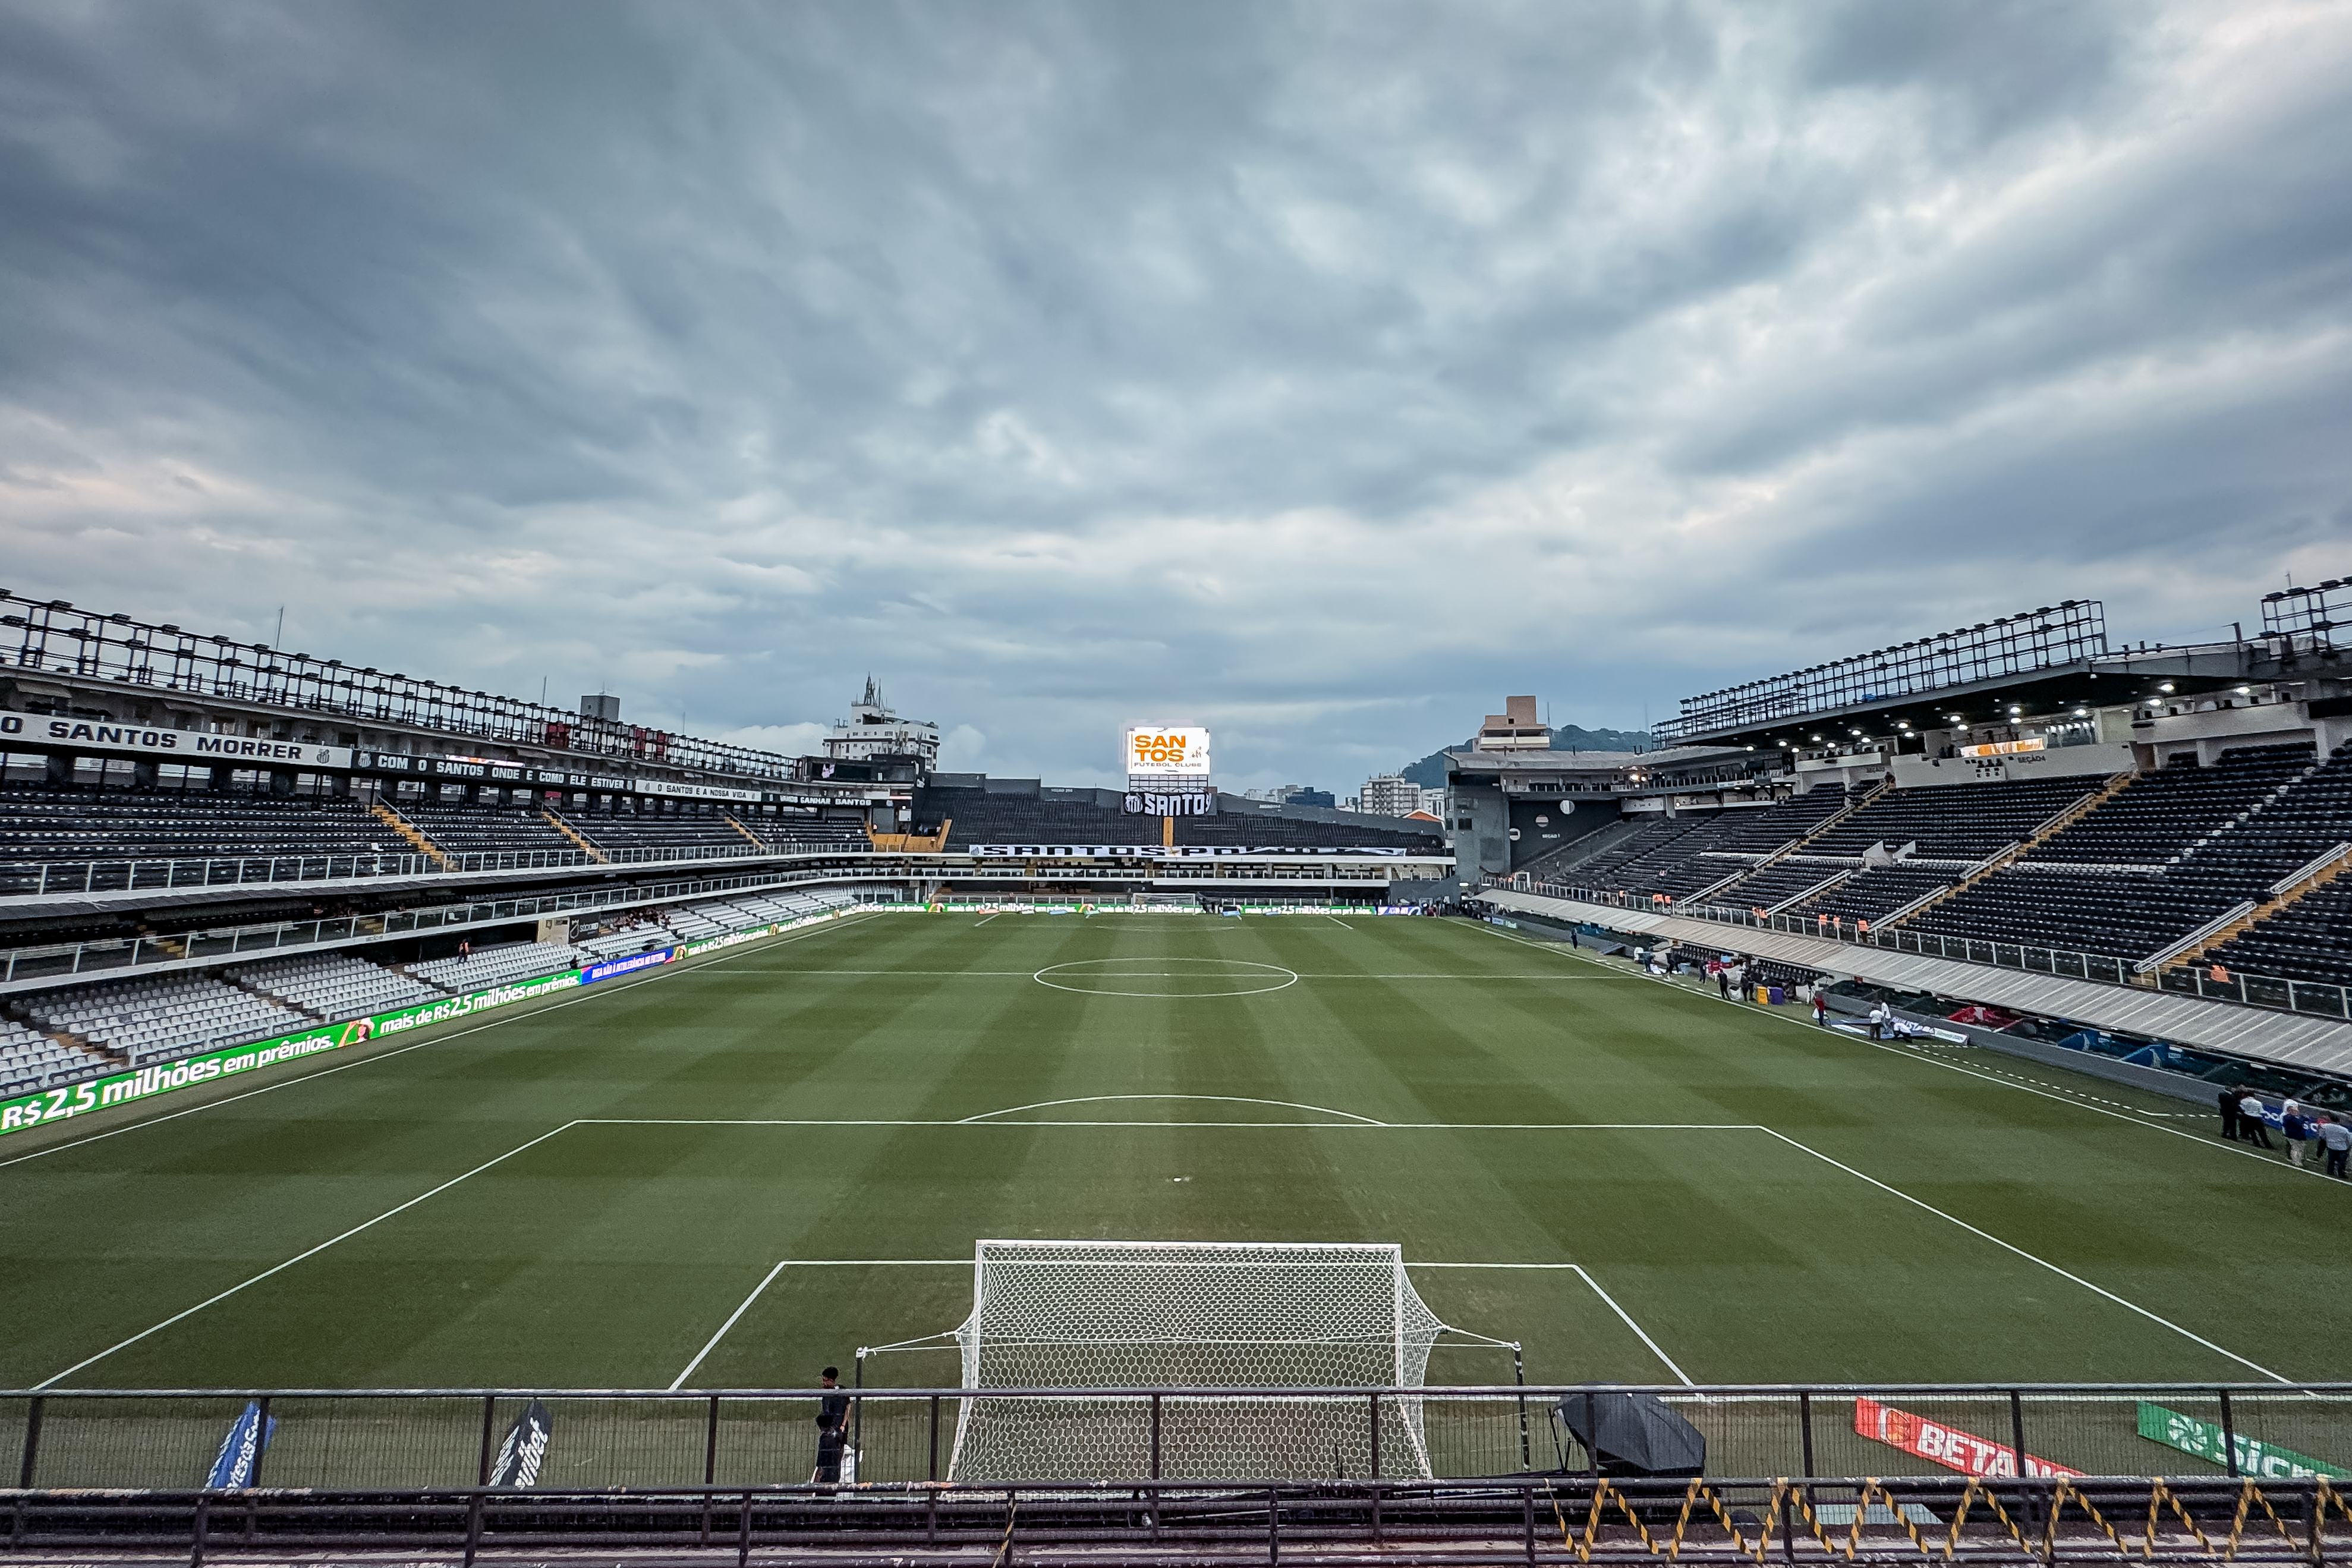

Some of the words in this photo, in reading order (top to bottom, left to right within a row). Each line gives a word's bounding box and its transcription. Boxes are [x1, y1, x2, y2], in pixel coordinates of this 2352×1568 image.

[1, 717, 24, 733] O
[49, 722, 177, 748] SANTOS
[197, 737, 302, 759] MORRER
[1135, 735, 1186, 748] SAN
[1135, 749, 1184, 761] TOS
[378, 755, 408, 769] COM
[418, 760, 427, 771] O
[437, 761, 484, 776] SANTOS
[492, 767, 520, 779] ONDE
[539, 772, 564, 783] COMO
[570, 775, 587, 786] ELE
[591, 777, 624, 789] ESTIVER
[666, 785, 692, 794] SANTOS
[984, 846, 1166, 856] SANTOS
[380, 1013, 414, 1034] mais
[416, 1009, 432, 1025] de
[473, 985, 526, 1010] milhões
[527, 984, 540, 996] em
[101, 1059, 221, 1104] milhões
[223, 1052, 254, 1070] em
[257, 1035, 334, 1068] prêmios.
[1917, 1422, 2074, 1478] BETA
